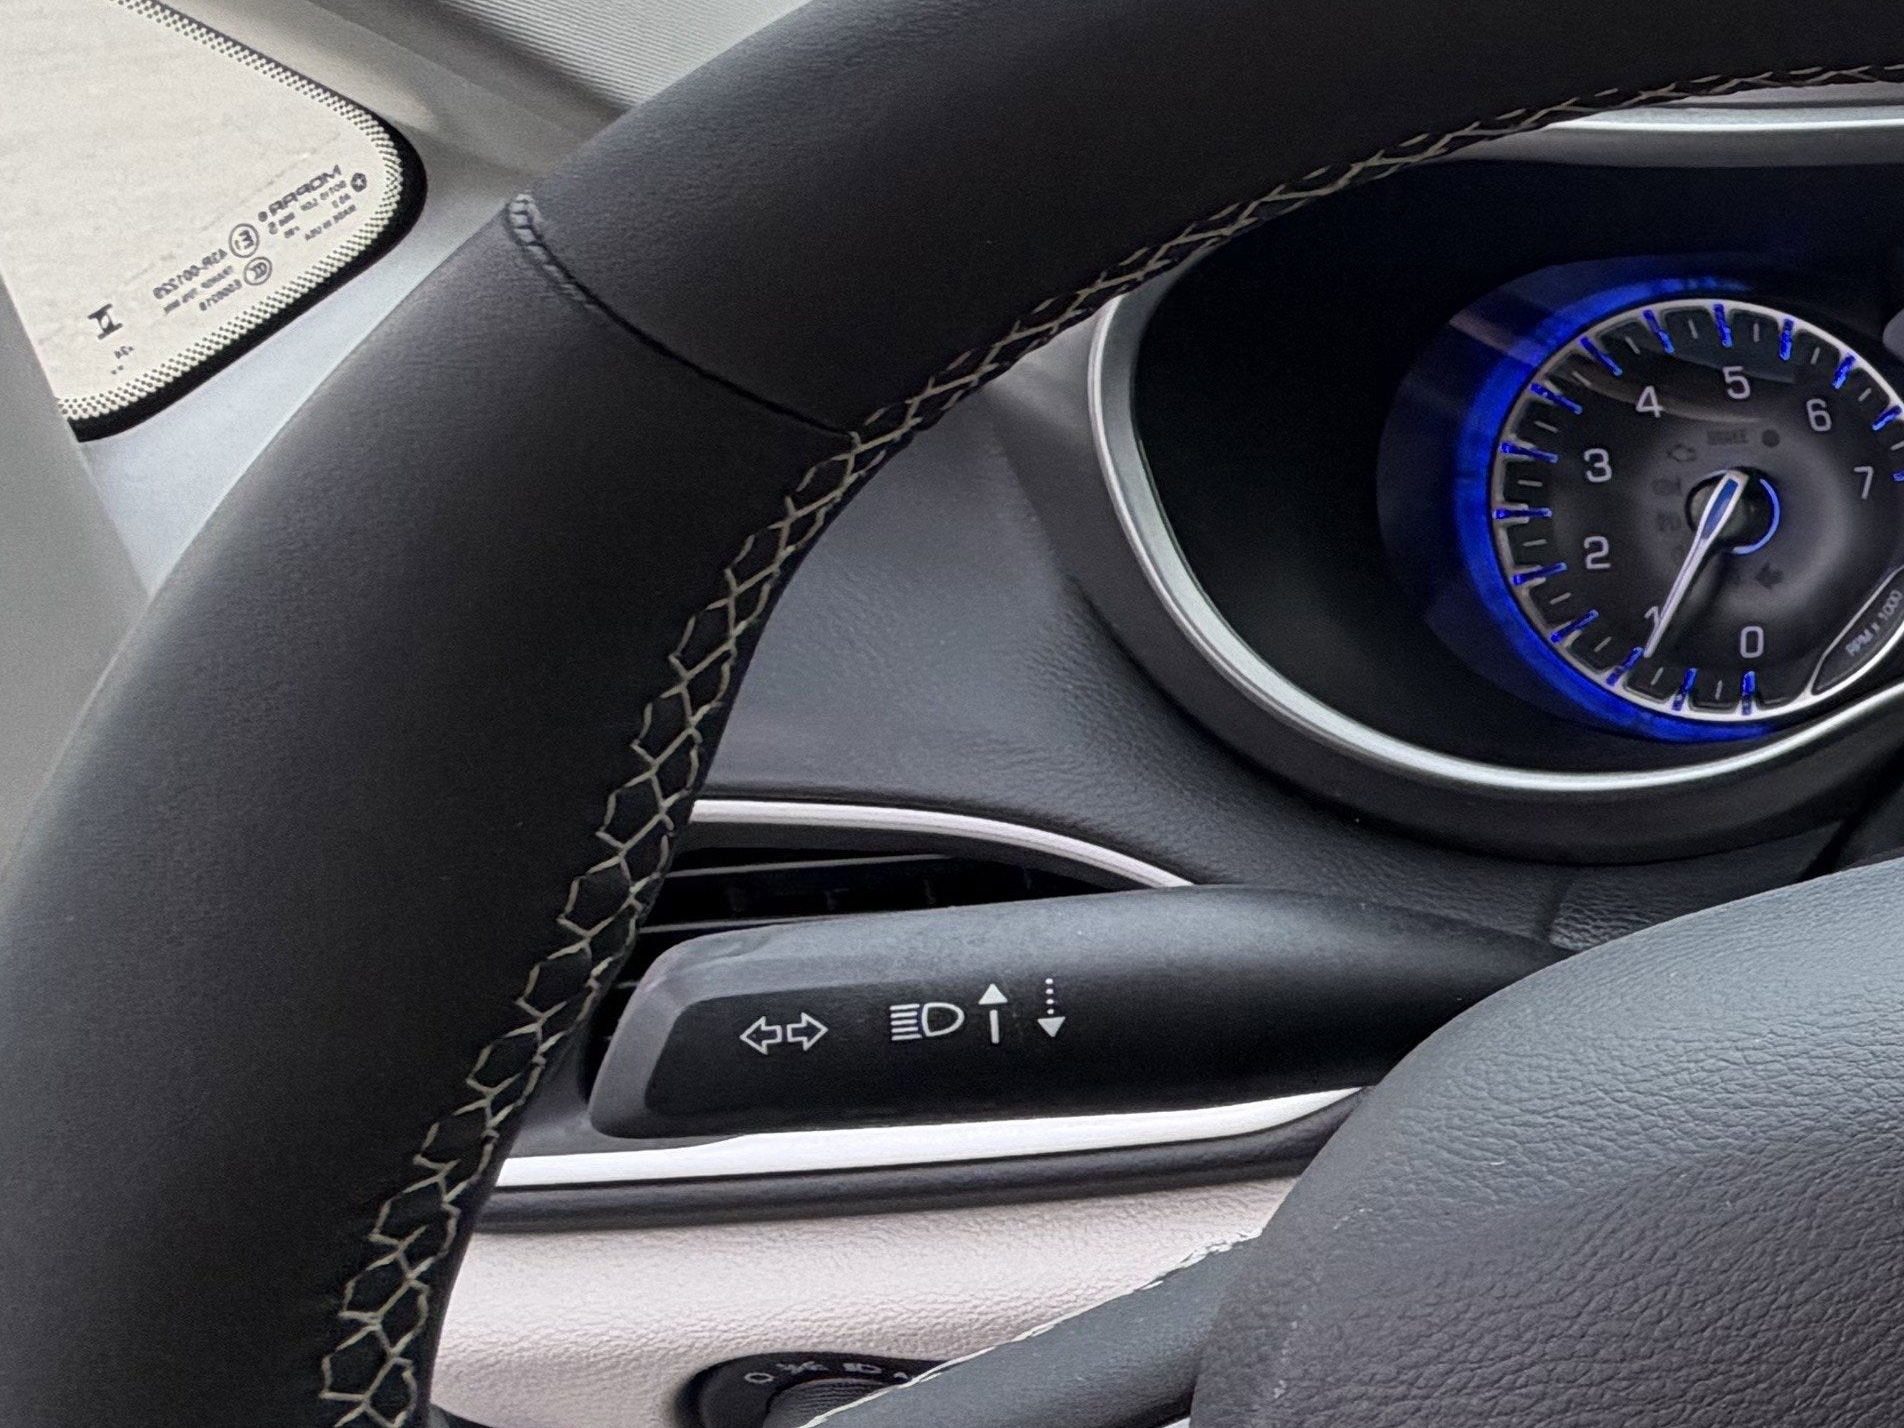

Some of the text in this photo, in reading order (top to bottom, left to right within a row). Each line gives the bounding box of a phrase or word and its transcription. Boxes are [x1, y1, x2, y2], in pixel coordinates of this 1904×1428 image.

[1722, 366, 1750, 399] 5
[1635, 385, 1663, 418] 4
[1806, 398, 1832, 432] 6
[1583, 448, 1612, 483] 3
[1854, 466, 1874, 500] 7
[1583, 536, 1611, 570] 2
[1878, 589, 1903, 621] 1000
[1739, 626, 1764, 659] 0
